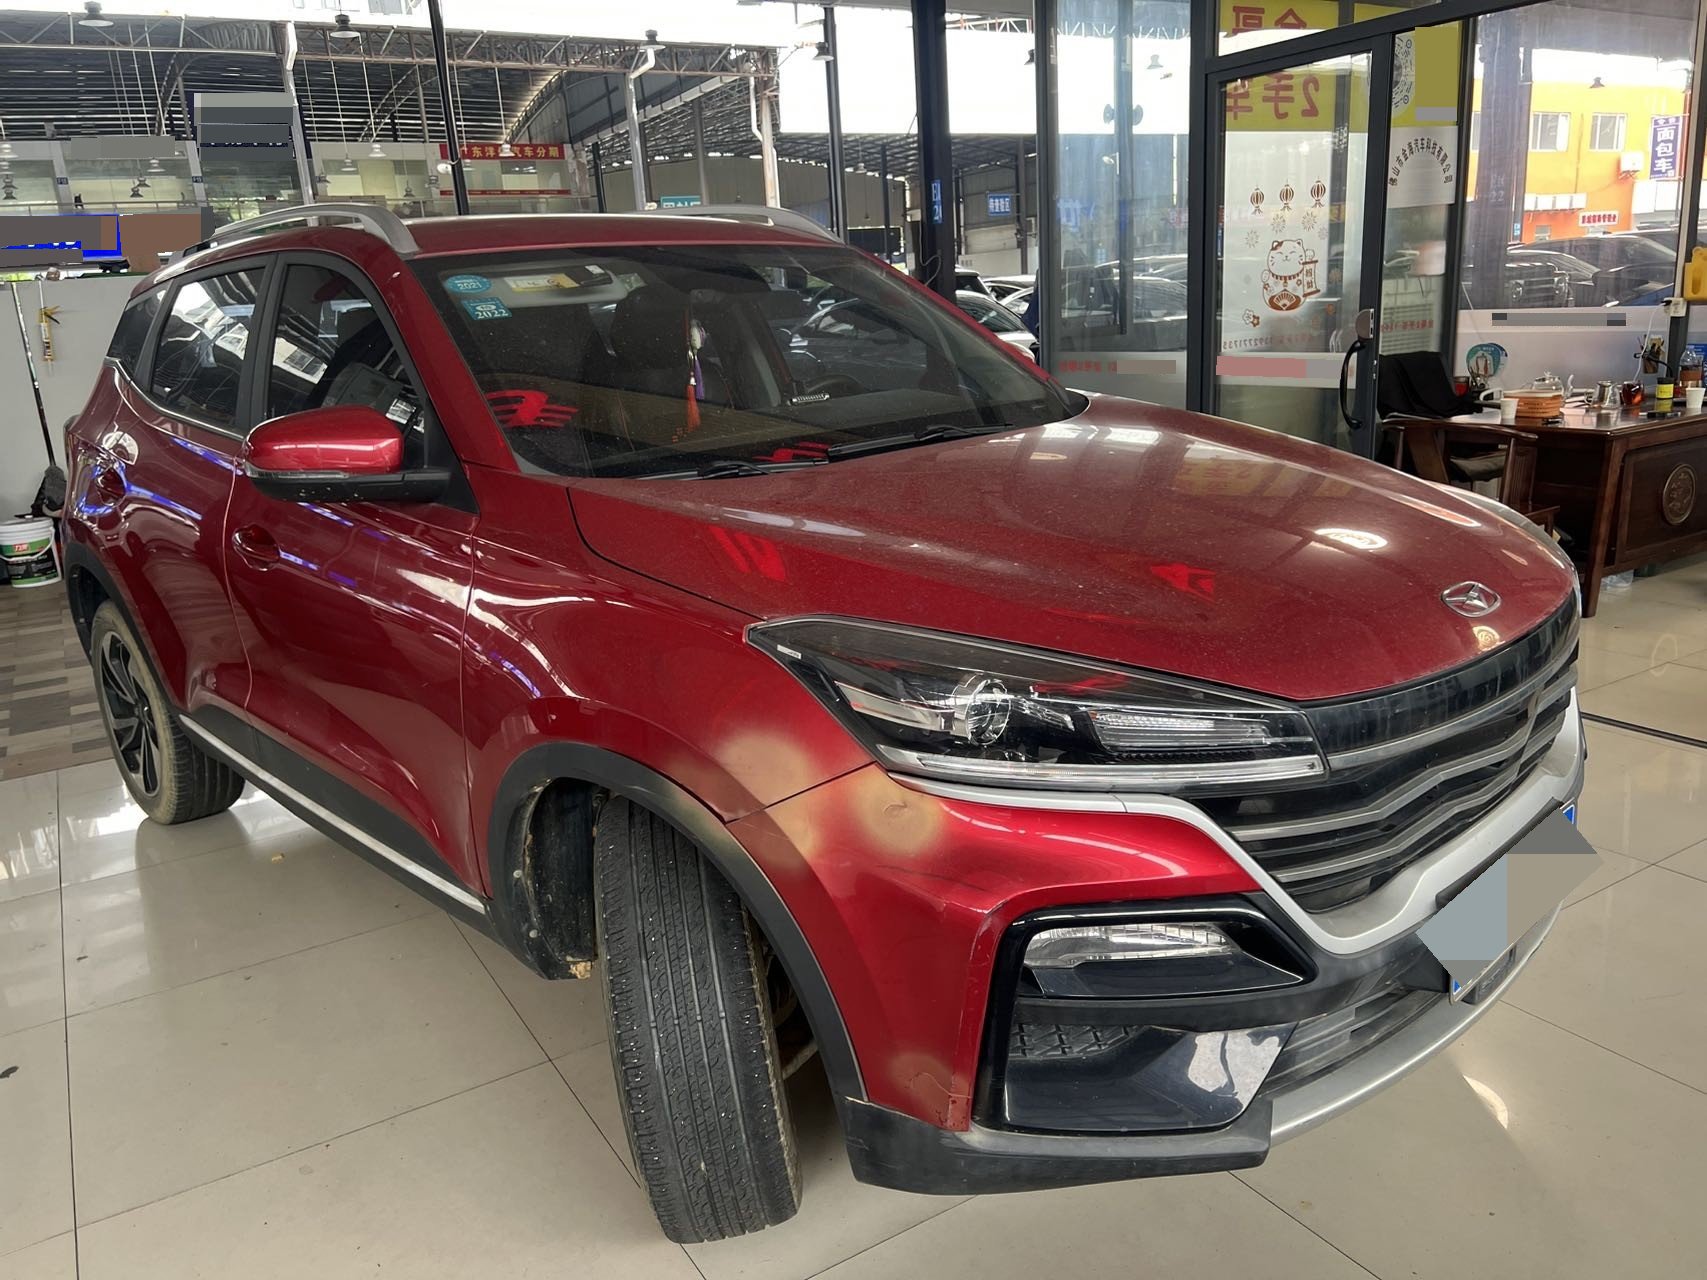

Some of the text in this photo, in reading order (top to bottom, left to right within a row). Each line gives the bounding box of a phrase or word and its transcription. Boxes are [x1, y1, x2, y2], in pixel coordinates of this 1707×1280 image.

[1653, 126, 1676, 173] 面包车
[457, 281, 482, 290] 2021
[475, 309, 509, 319] 2022
